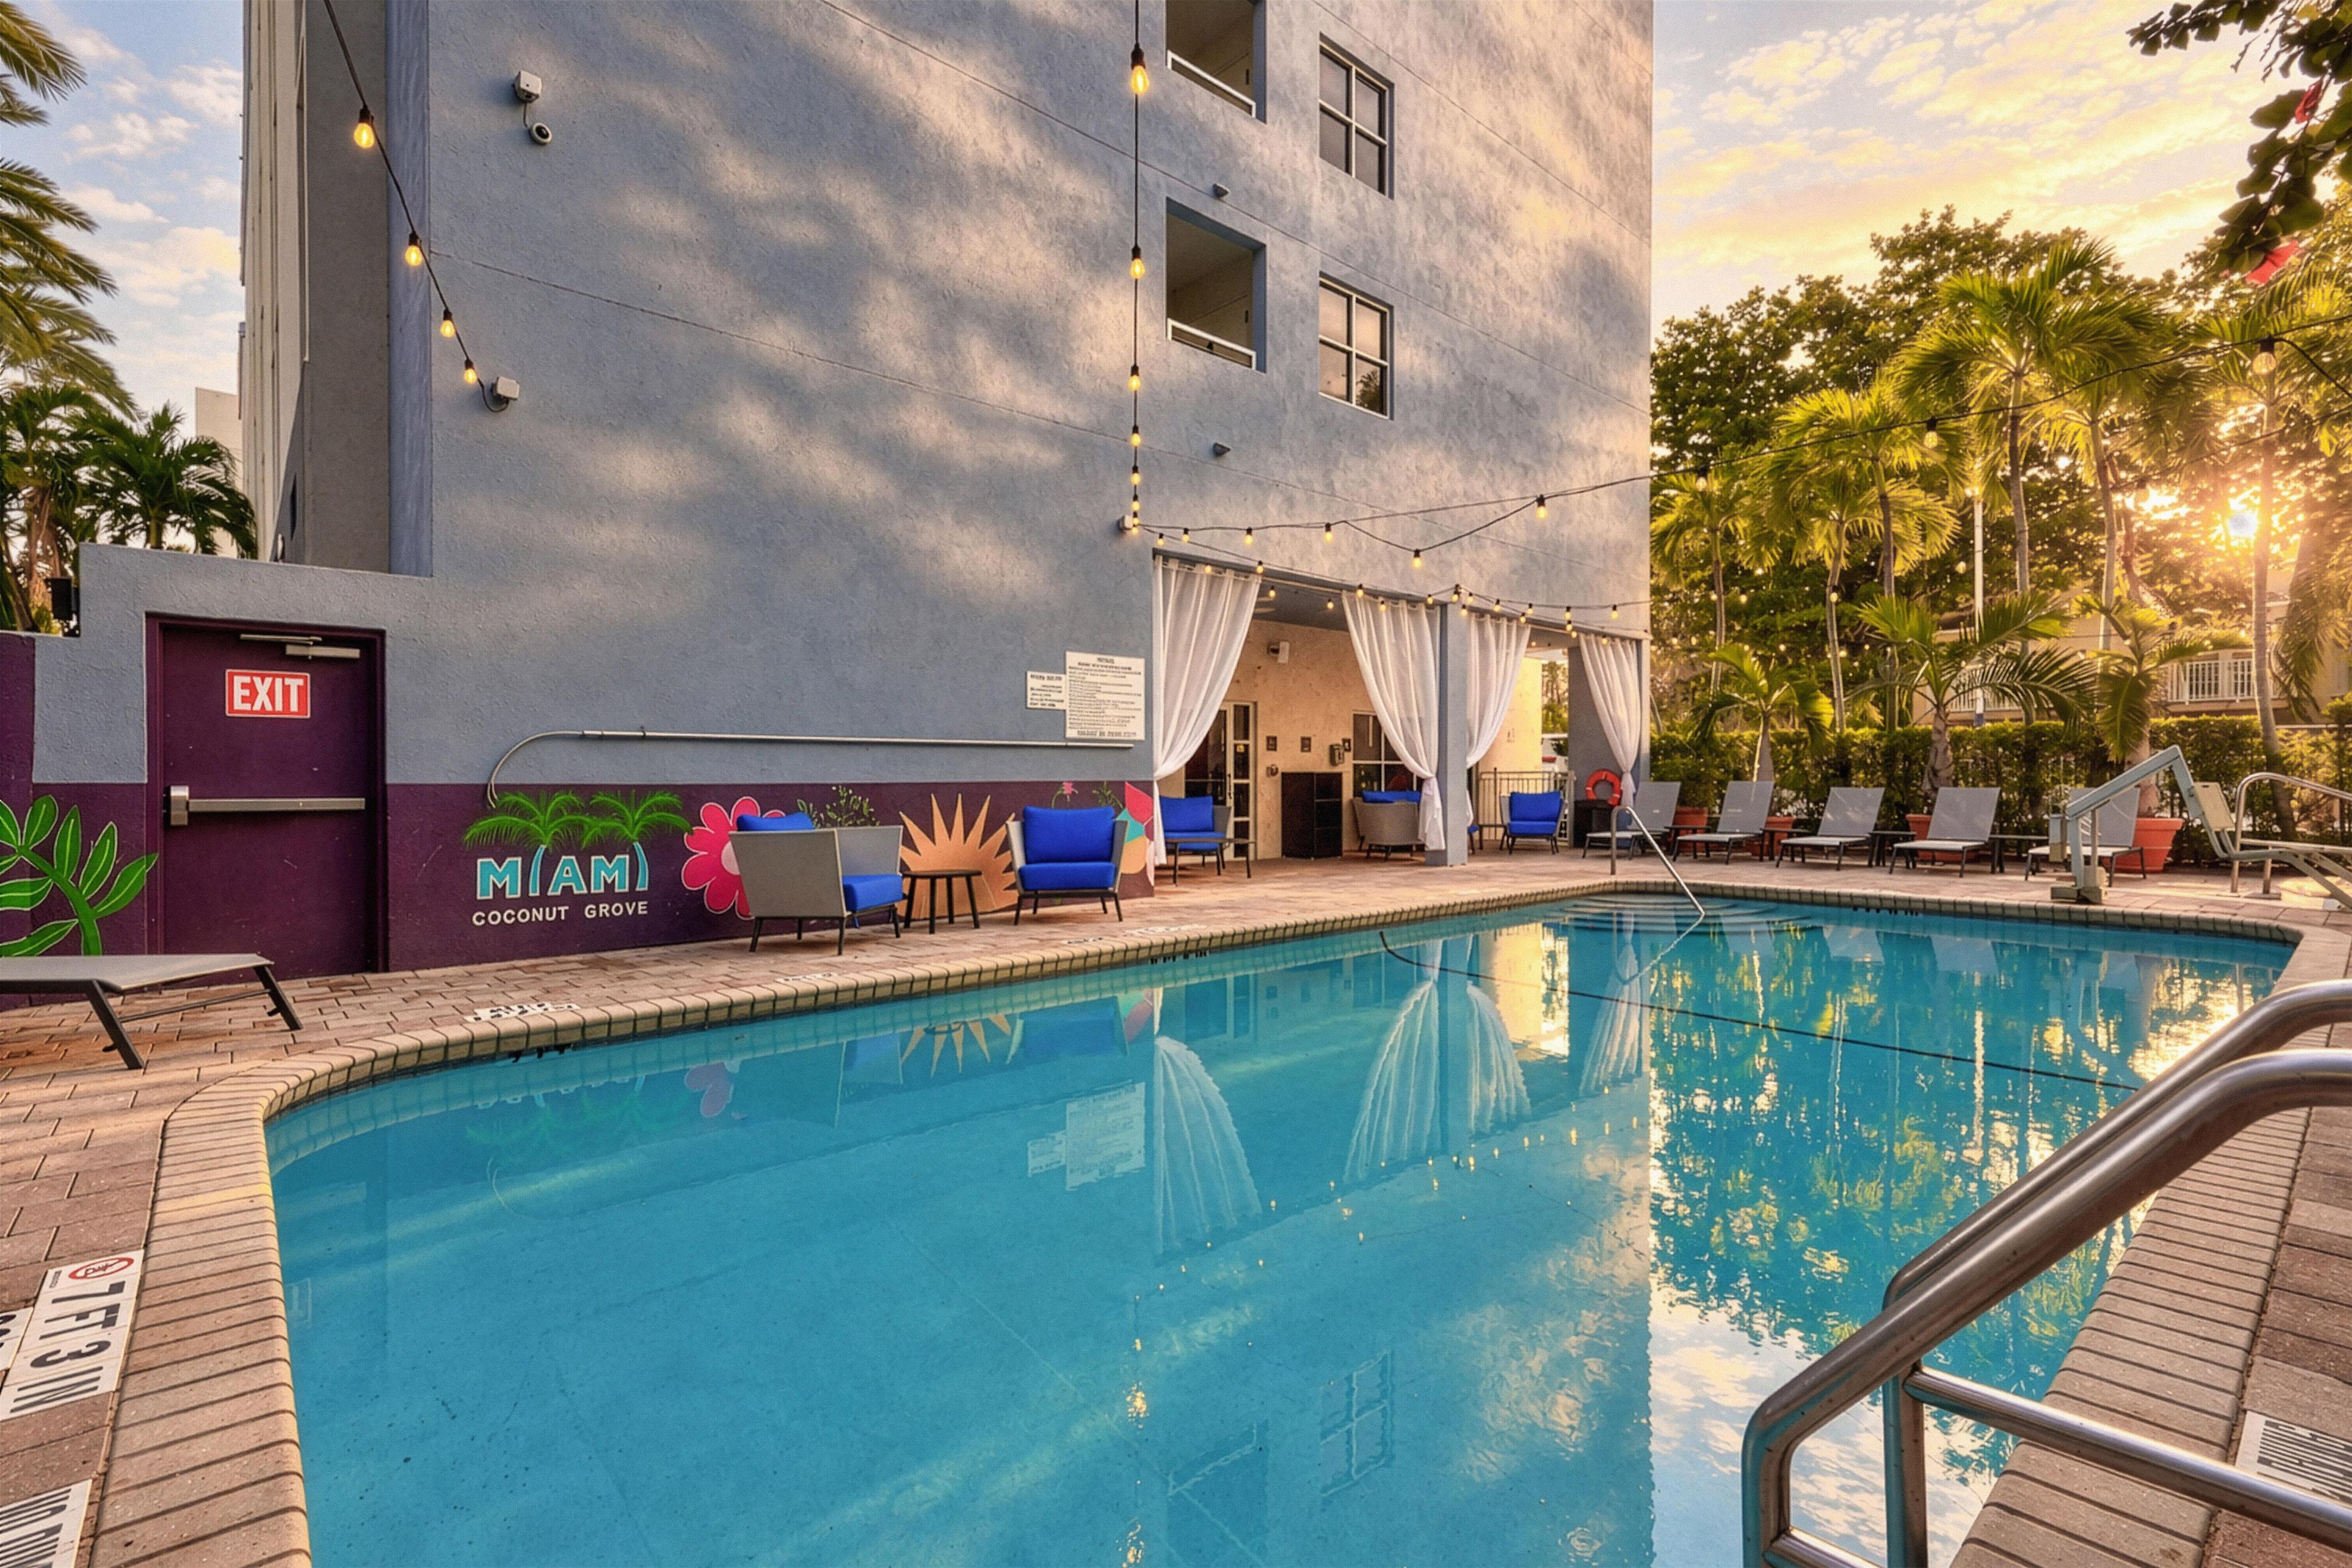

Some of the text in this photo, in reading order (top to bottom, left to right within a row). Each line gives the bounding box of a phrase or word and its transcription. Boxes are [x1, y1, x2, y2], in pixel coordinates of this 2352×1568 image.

[233, 675, 304, 712] EXIT
[477, 841, 649, 900] MIAMI
[472, 901, 649, 926] COCONUT GROVE
